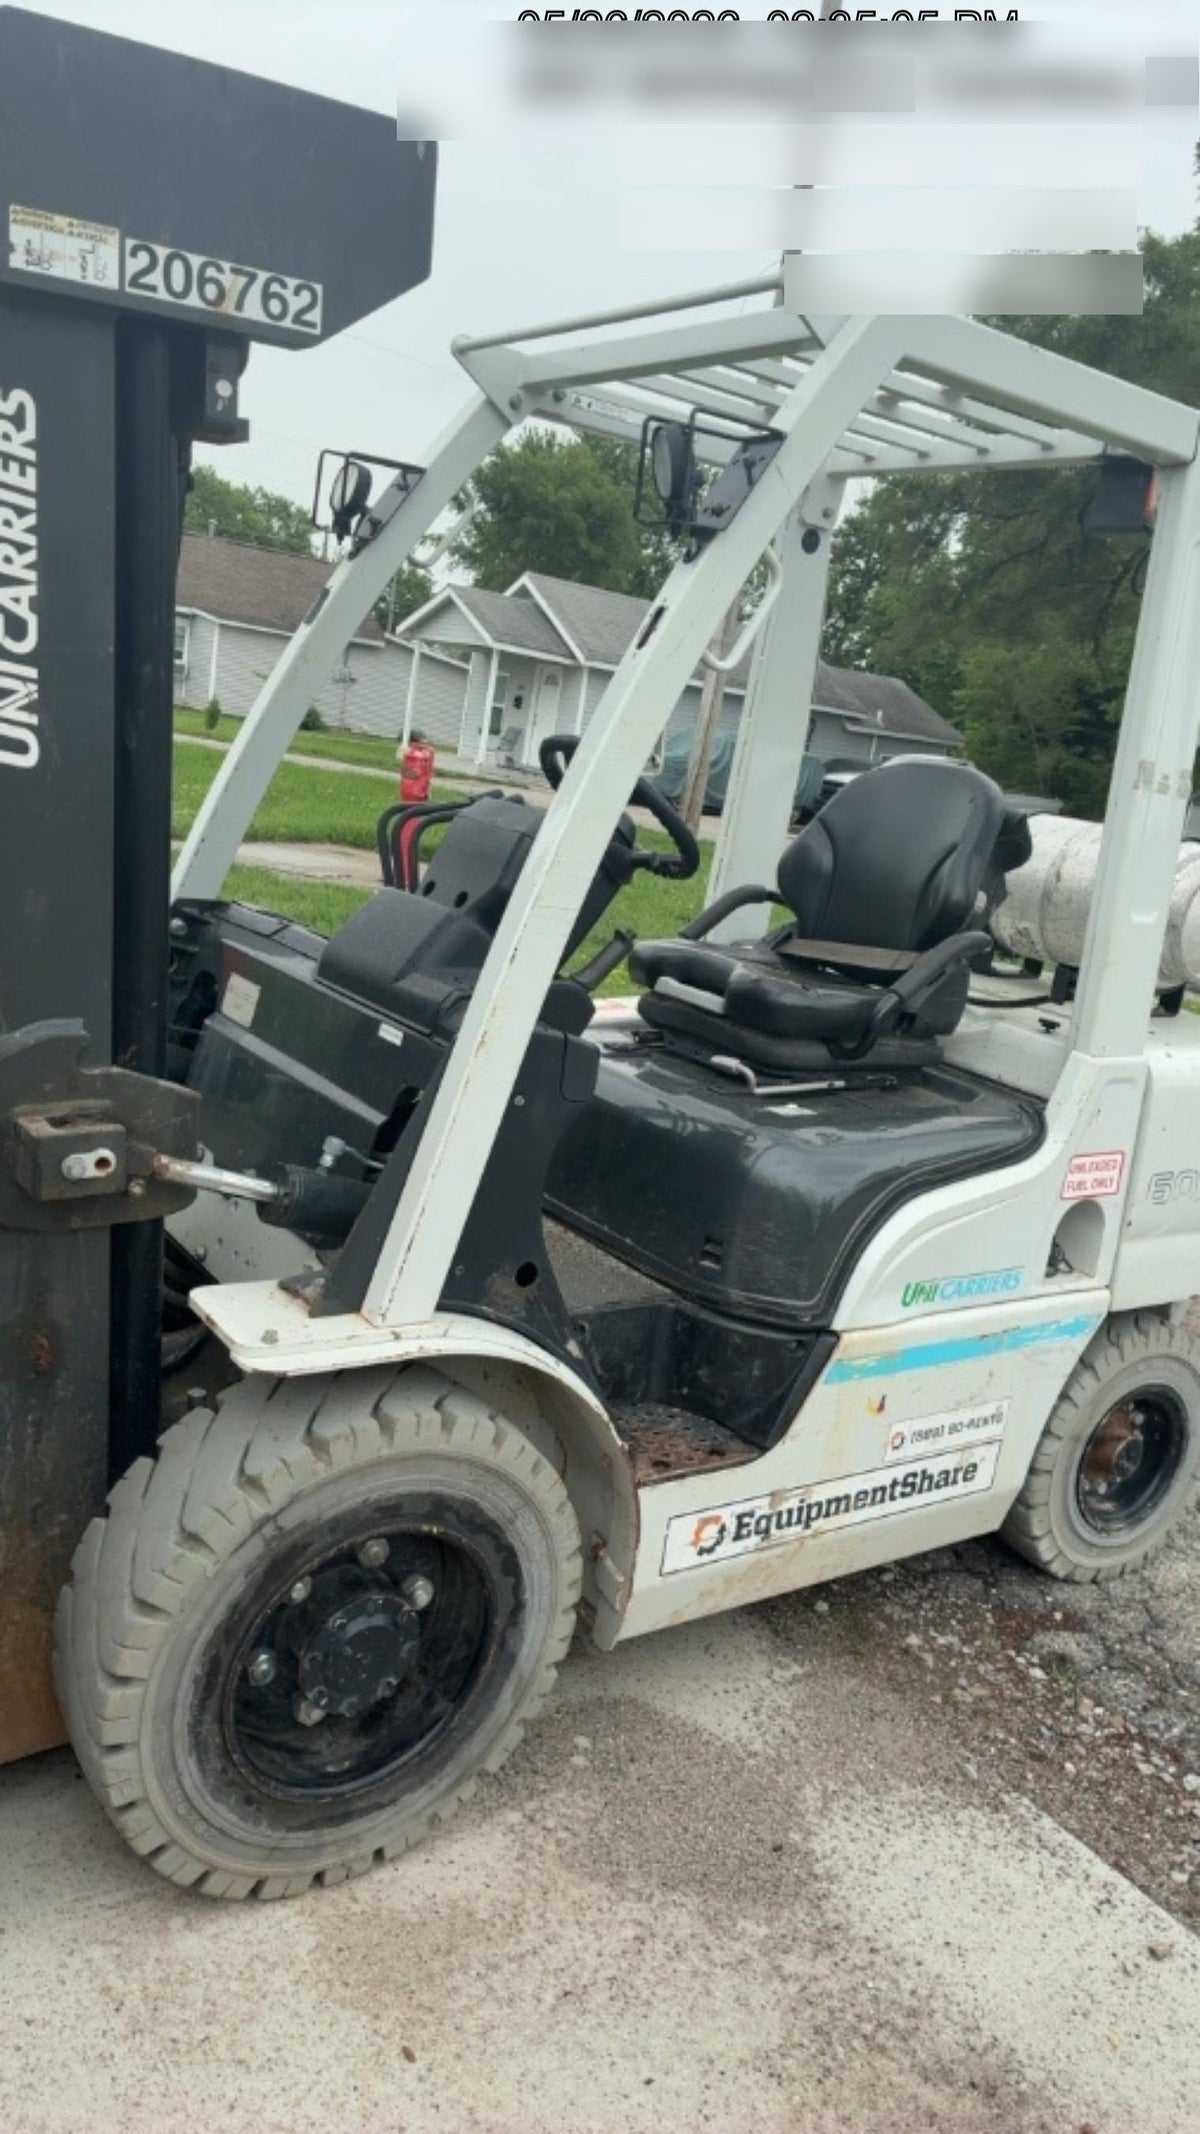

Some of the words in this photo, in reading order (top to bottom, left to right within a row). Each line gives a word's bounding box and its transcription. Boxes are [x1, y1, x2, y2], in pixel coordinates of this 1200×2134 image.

[127, 242, 319, 329] 206762
[1066, 1180, 1089, 1192] FUEL
[1091, 1177, 1114, 1190] ONLY
[731, 1461, 979, 1543] EquipmentShare
